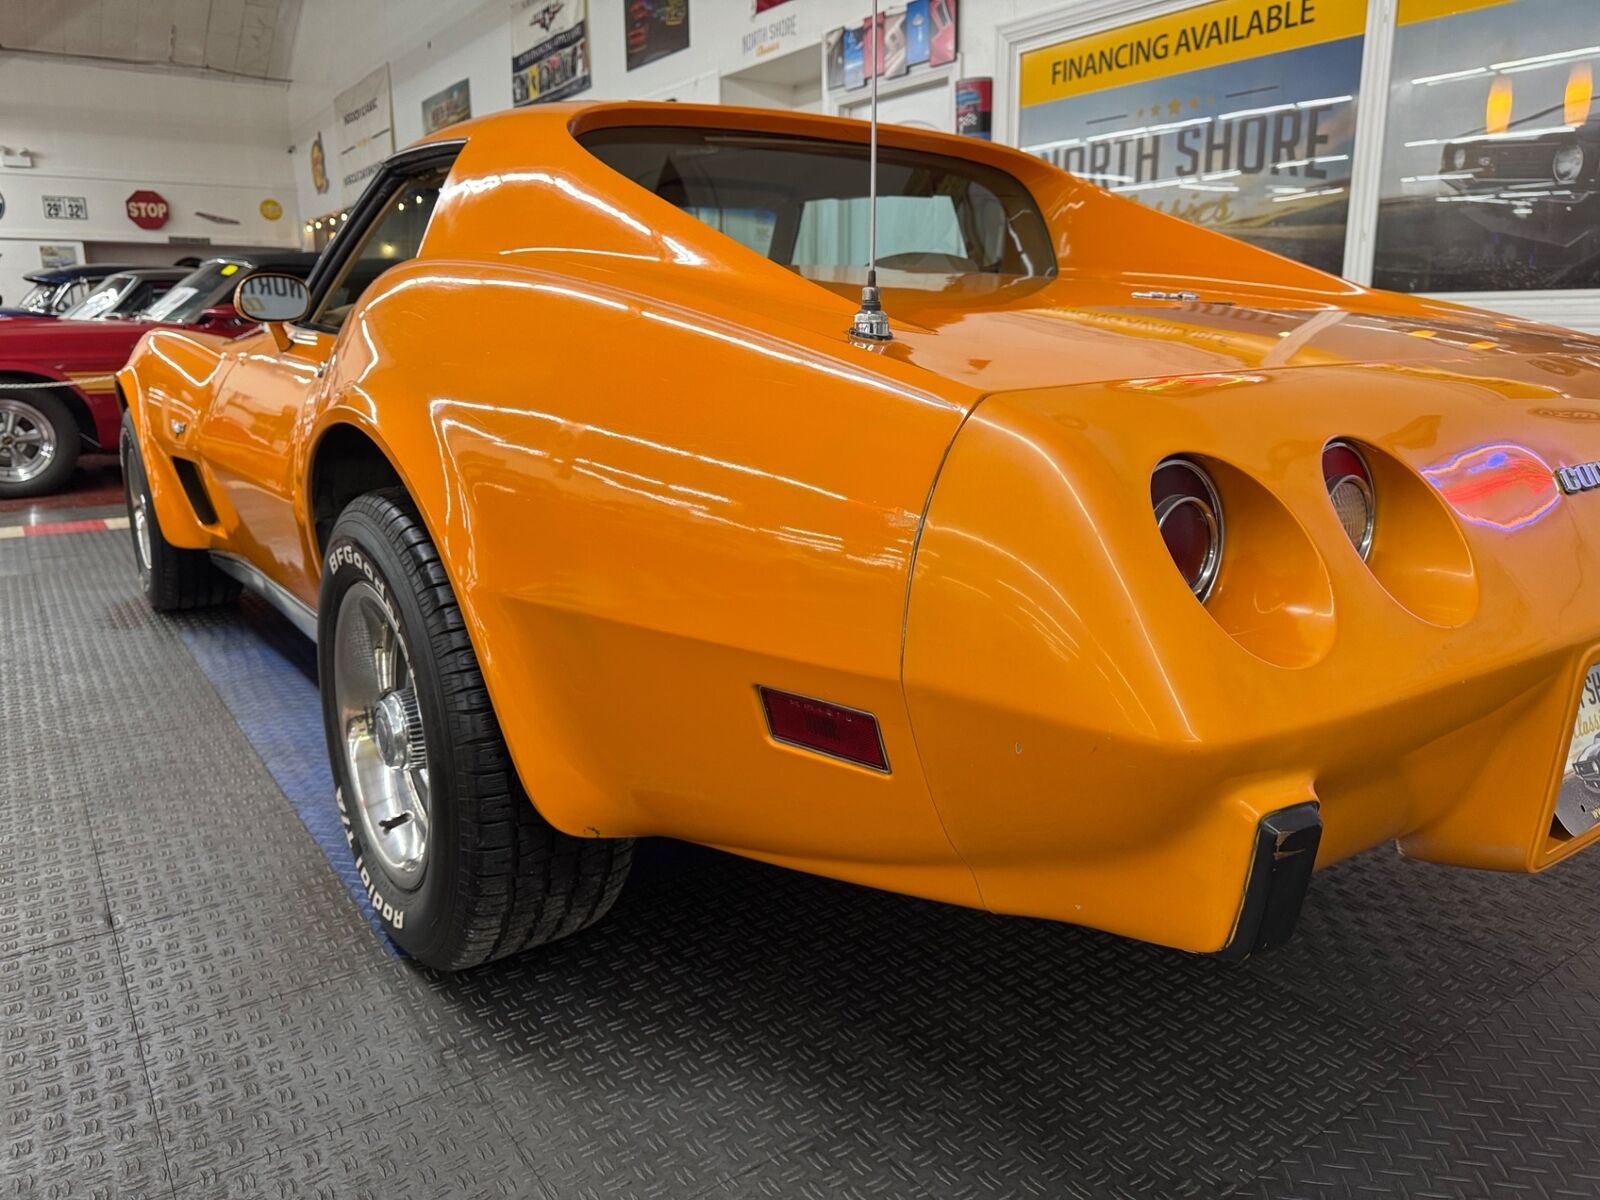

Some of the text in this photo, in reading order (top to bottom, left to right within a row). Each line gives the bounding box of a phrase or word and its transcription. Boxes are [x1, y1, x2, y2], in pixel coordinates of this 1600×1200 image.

[1051, 0, 1316, 85] FINANCING AVAILABLE
[1176, 104, 1334, 179] SHORE
[128, 201, 167, 219] STOP
[355, 855, 404, 929] Radial
